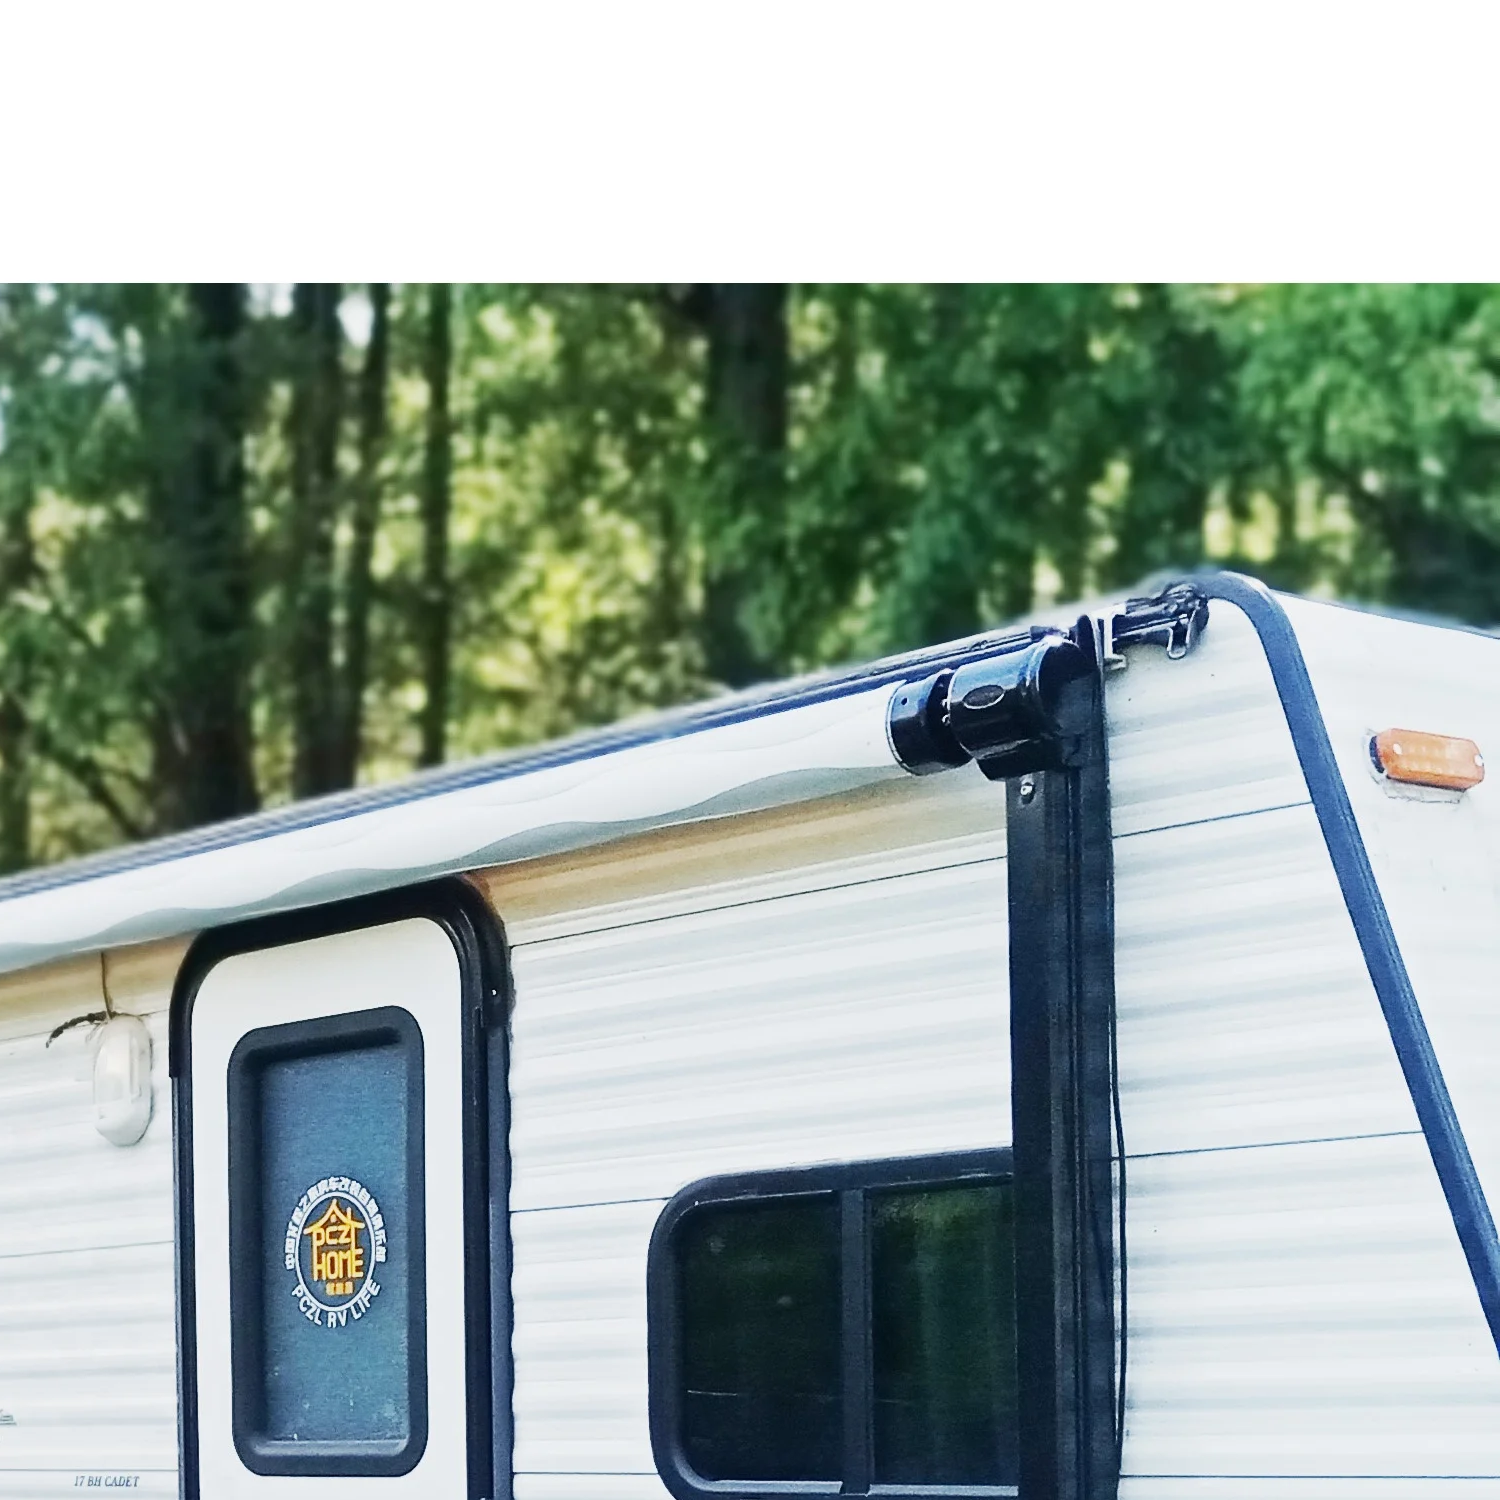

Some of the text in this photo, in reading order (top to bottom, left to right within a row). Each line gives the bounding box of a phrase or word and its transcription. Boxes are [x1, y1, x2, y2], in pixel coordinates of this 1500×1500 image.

[312, 1248, 363, 1281] HOME
[291, 1279, 380, 1328] PCZL RV LIFE
[74, 1475, 140, 1487] 17 BH CADET
